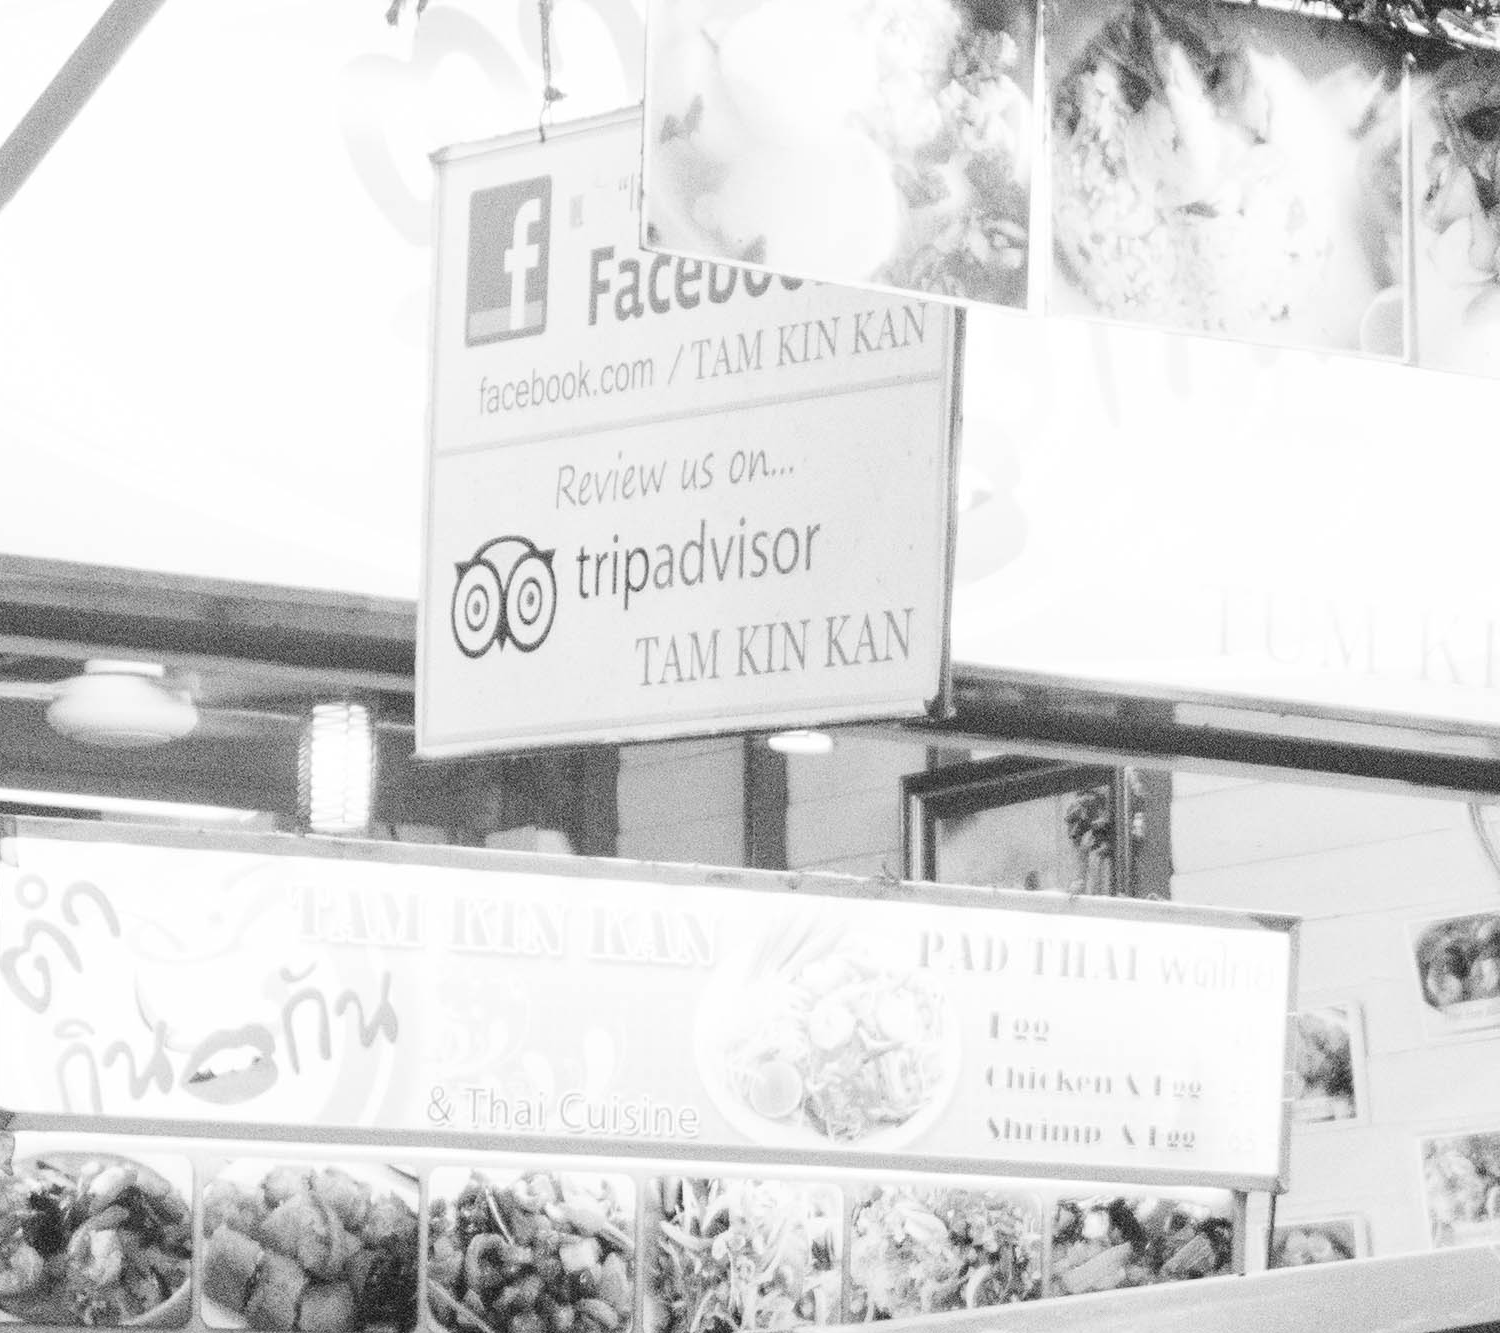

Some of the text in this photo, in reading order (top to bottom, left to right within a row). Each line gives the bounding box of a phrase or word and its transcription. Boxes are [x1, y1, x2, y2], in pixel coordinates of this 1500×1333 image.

[588, 244, 822, 326] Facebo
[479, 358, 653, 416] facebook.com
[692, 328, 764, 381] TAM
[777, 316, 839, 367] KIN
[851, 302, 928, 355] KAN
[555, 444, 794, 509] Review us on...
[576, 518, 821, 609] tripadvisor
[635, 608, 915, 686] TAM KIN KAN
[289, 884, 717, 968] TAM KIN KAN
[918, 930, 1139, 982] PAD THAI
[465, 1088, 545, 1131] Thai
[558, 1092, 699, 1136] Cuisine
